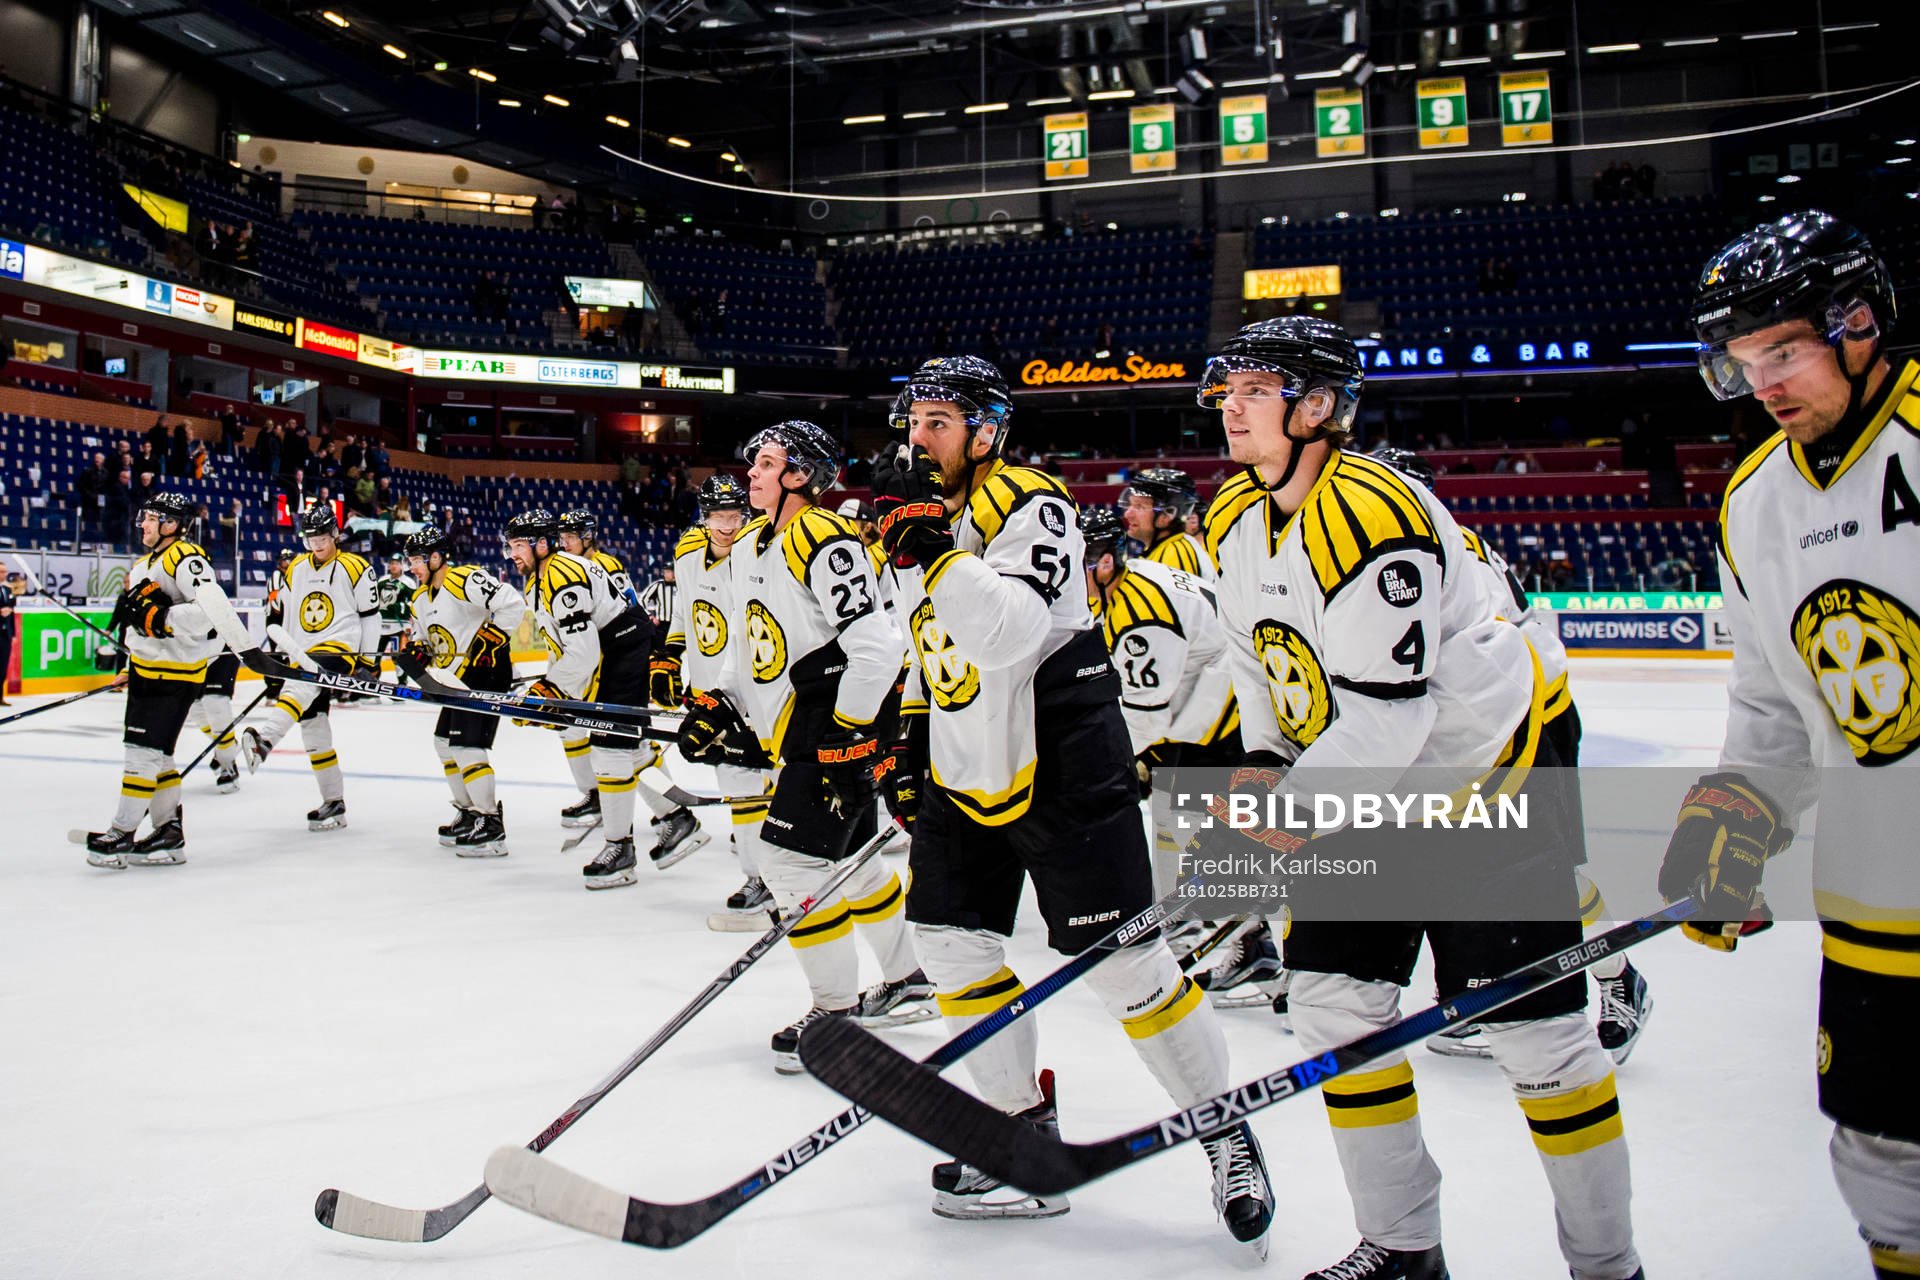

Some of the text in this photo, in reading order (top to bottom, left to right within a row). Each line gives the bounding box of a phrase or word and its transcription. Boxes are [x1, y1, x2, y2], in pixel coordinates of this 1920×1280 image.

[1431, 98, 1453, 125] 9
[1508, 92, 1541, 121] 17
[1233, 115, 1255, 143] 5
[1329, 107, 1351, 135] 2
[1051, 131, 1082, 160] 21
[1142, 124, 1163, 150] 9
[1833, 256, 1867, 276] BAUER
[236, 311, 285, 334] KARLSTAD.SE
[1697, 305, 1732, 324] BAUER
[304, 328, 357, 353] McDonald's
[1471, 344, 1491, 363] &
[1518, 341, 1590, 362] BAR
[439, 358, 505, 374] PEAB
[1021, 354, 1186, 385] Golden Star
[1881, 452, 1920, 534] A
[1799, 523, 1839, 550] unicef
[1383, 569, 1398, 582] EN
[1385, 578, 1407, 592] BRA
[830, 573, 873, 619] 23
[1388, 587, 1418, 602] START
[1817, 588, 1852, 616] 1912
[1262, 625, 1285, 644] 1912
[1563, 620, 1669, 640] SWEDWISE
[1835, 628, 1850, 651] B
[1392, 619, 1426, 676] 4
[1075, 662, 1108, 678] BAUER
[1124, 658, 1160, 689] 16
[318, 672, 395, 696] NEXUS
[574, 717, 615, 731] BAUER
[1068, 909, 1121, 927] BAUER
[1116, 903, 1167, 945] BAUER
[1557, 938, 1611, 972] BAUER
[1126, 986, 1164, 1013] BAUER
[1159, 1069, 1295, 1147] NEXUS
